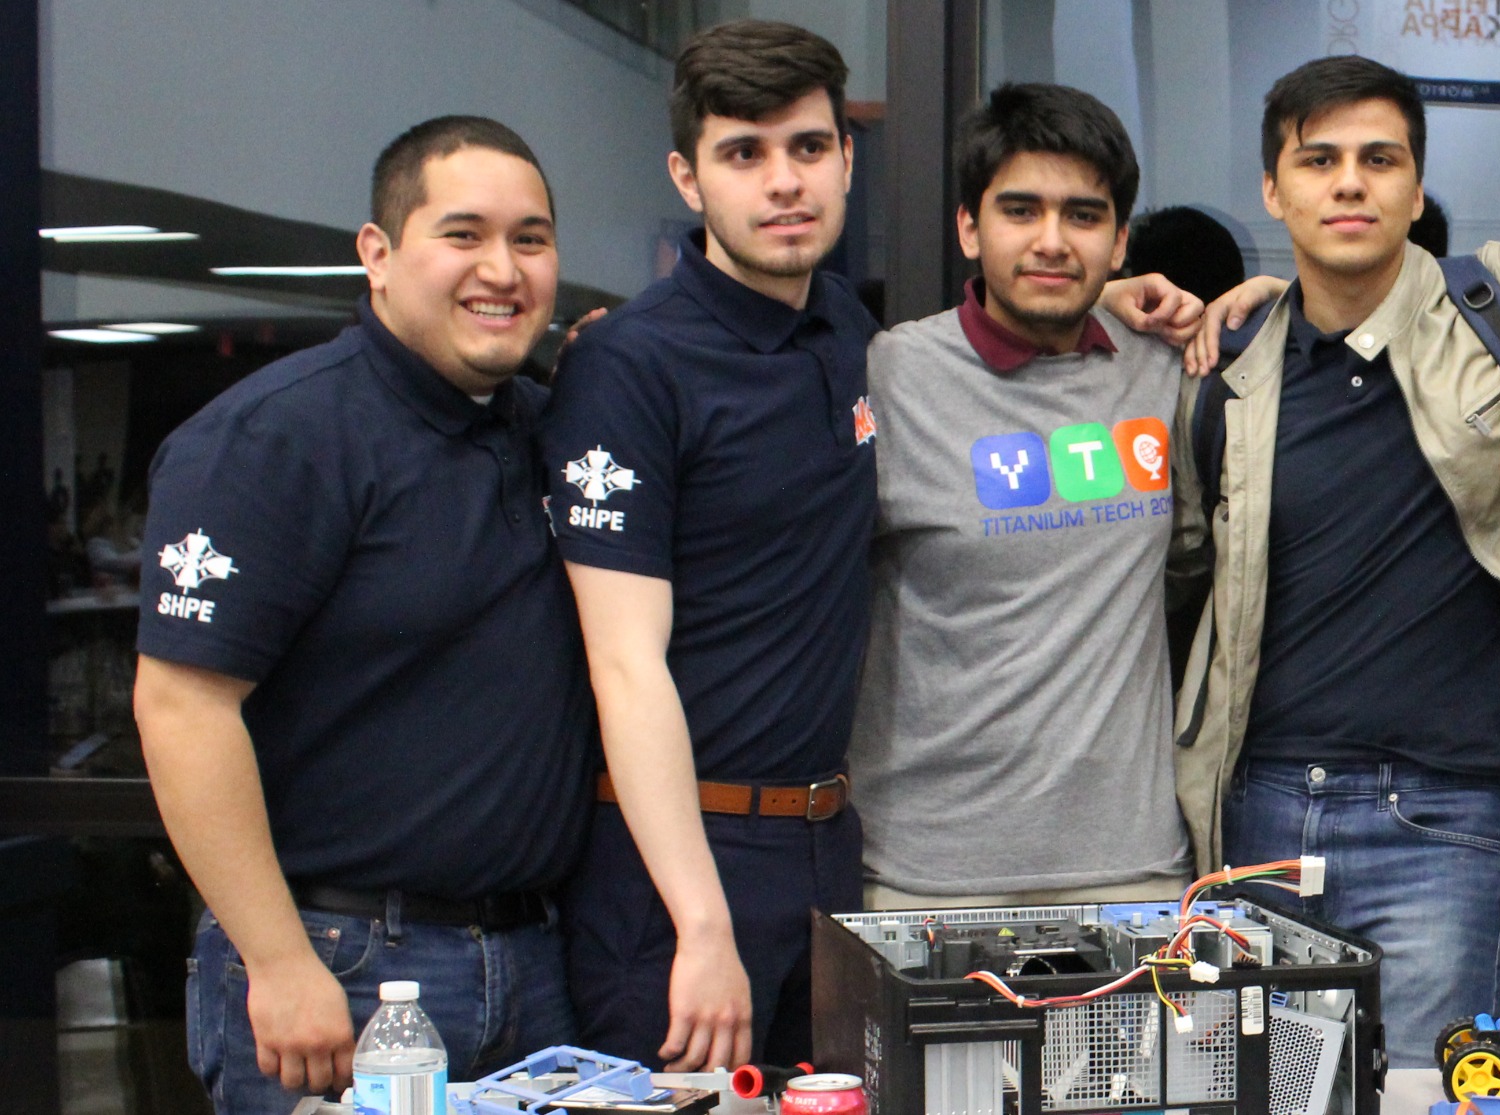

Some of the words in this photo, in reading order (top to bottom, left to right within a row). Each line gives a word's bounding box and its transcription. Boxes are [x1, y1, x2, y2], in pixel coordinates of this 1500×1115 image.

[568, 504, 625, 532] SHPE
[979, 509, 1084, 537] TITANIUM
[1091, 500, 1145, 525] TECH
[157, 591, 216, 624] SHPE
